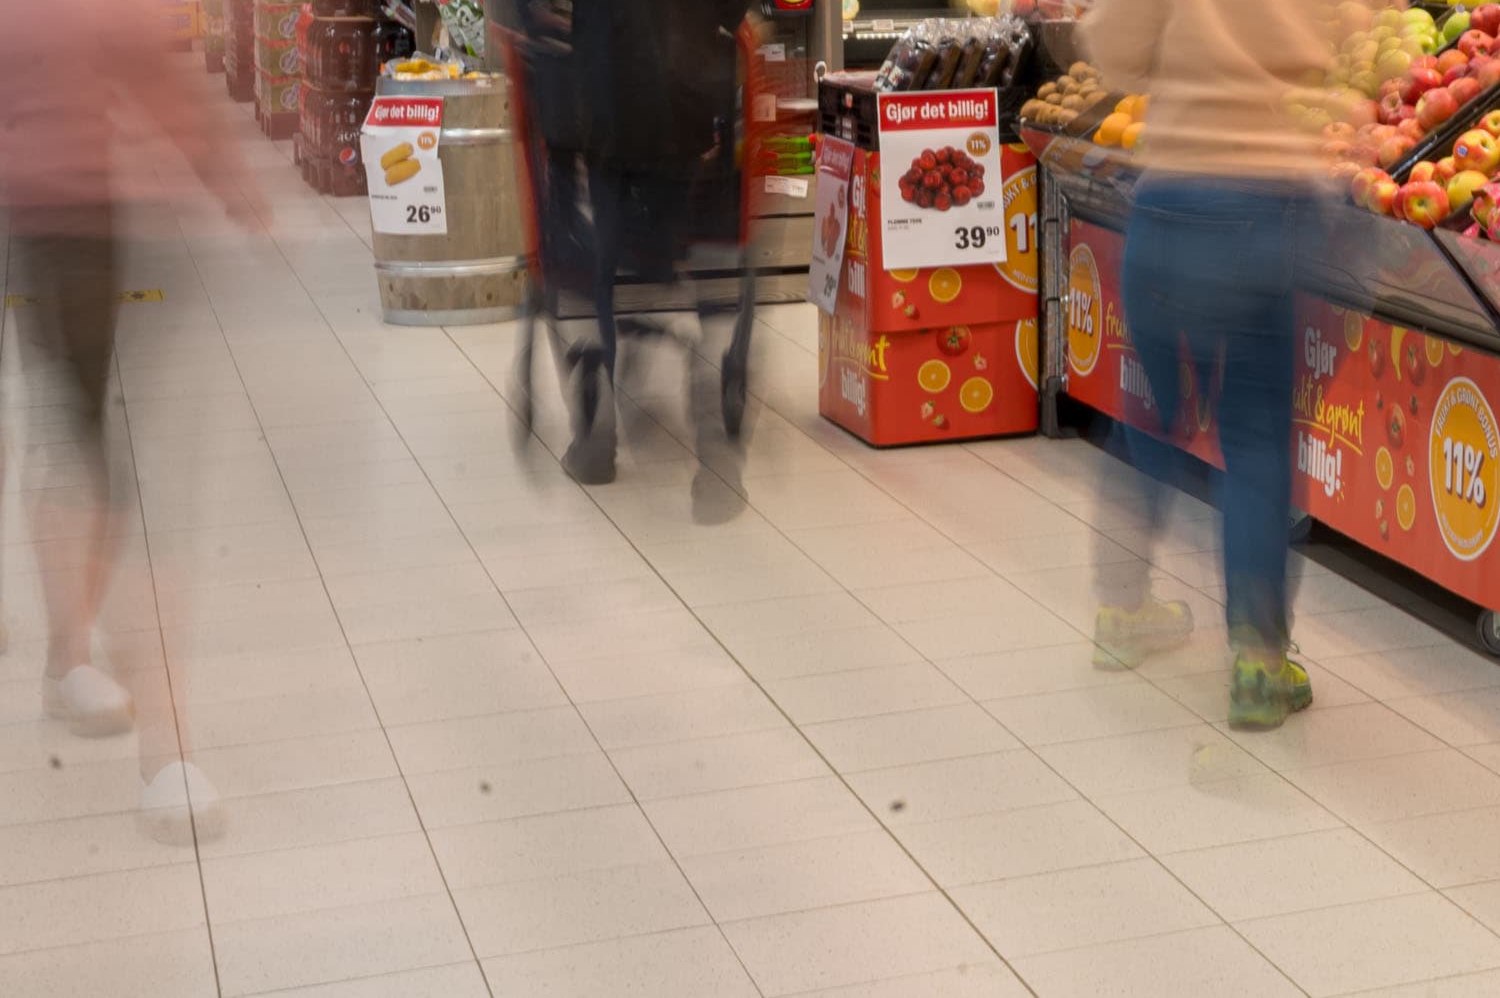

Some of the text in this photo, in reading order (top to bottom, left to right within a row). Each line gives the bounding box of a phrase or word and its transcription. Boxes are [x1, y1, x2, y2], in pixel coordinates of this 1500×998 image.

[406, 105, 440, 122] billig!
[886, 100, 989, 123] Gjør det billig!
[1069, 287, 1094, 335] 11%
[1304, 326, 1337, 378] Gjør
[1315, 383, 1365, 447] & grønt
[1298, 430, 1343, 499] billig!
[1443, 437, 1485, 507] 11%
